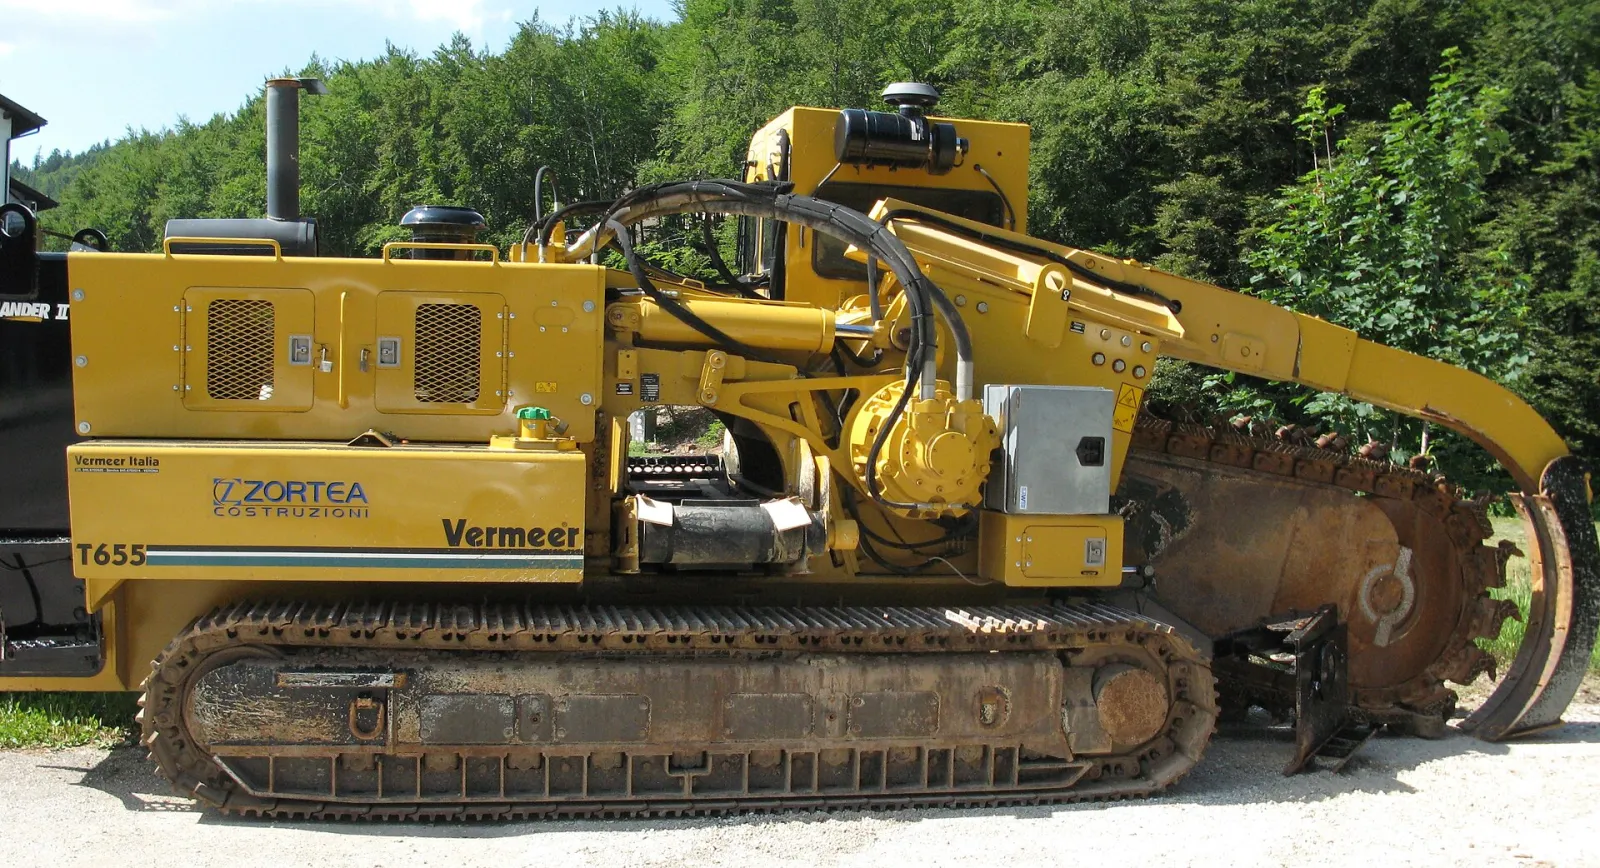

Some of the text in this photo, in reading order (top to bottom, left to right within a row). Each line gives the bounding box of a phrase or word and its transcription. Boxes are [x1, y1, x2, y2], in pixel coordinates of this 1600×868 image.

[75, 455, 159, 467] Vermeer Italia
[243, 480, 368, 504] ZORTEA
[213, 506, 368, 518] COSTRUZIONI
[442, 518, 580, 548] Vermeer
[76, 543, 146, 566] T655
